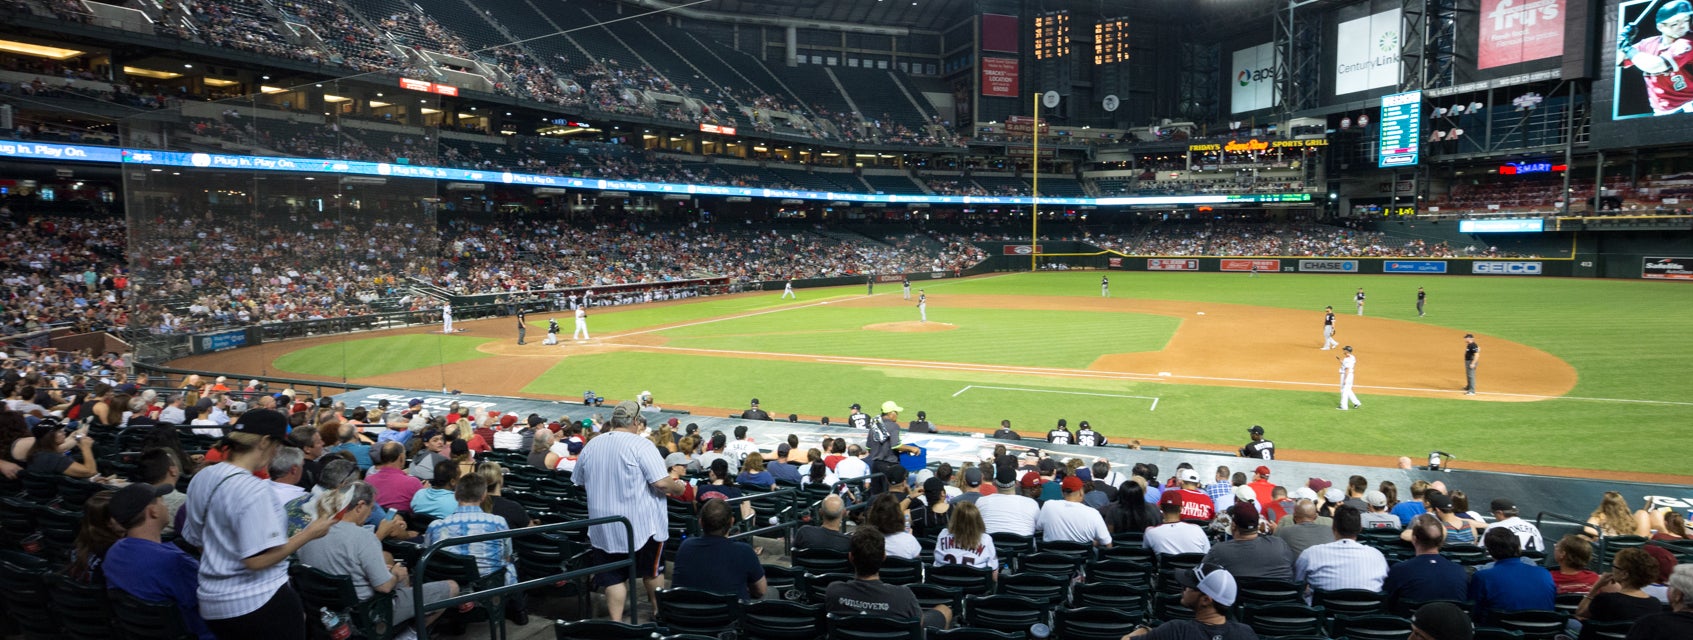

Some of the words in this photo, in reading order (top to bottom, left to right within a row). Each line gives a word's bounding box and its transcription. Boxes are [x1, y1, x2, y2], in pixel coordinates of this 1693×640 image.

[1338, 54, 1400, 75] CenturyLink
[1253, 65, 1274, 83] aps
[1272, 140, 1303, 148] SPORTS
[17, 144, 32, 154] In.
[35, 145, 62, 157] Play
[64, 146, 87, 157] On.
[214, 156, 238, 166] Plug
[254, 158, 276, 168] Play
[1304, 262, 1341, 270] CHASE
[1474, 262, 1541, 273] GEICO
[1645, 262, 1684, 270] Safelite
[855, 419, 867, 430] 12
[1052, 436, 1067, 445] 46
[1078, 435, 1095, 447] 36
[1261, 449, 1271, 460] 8
